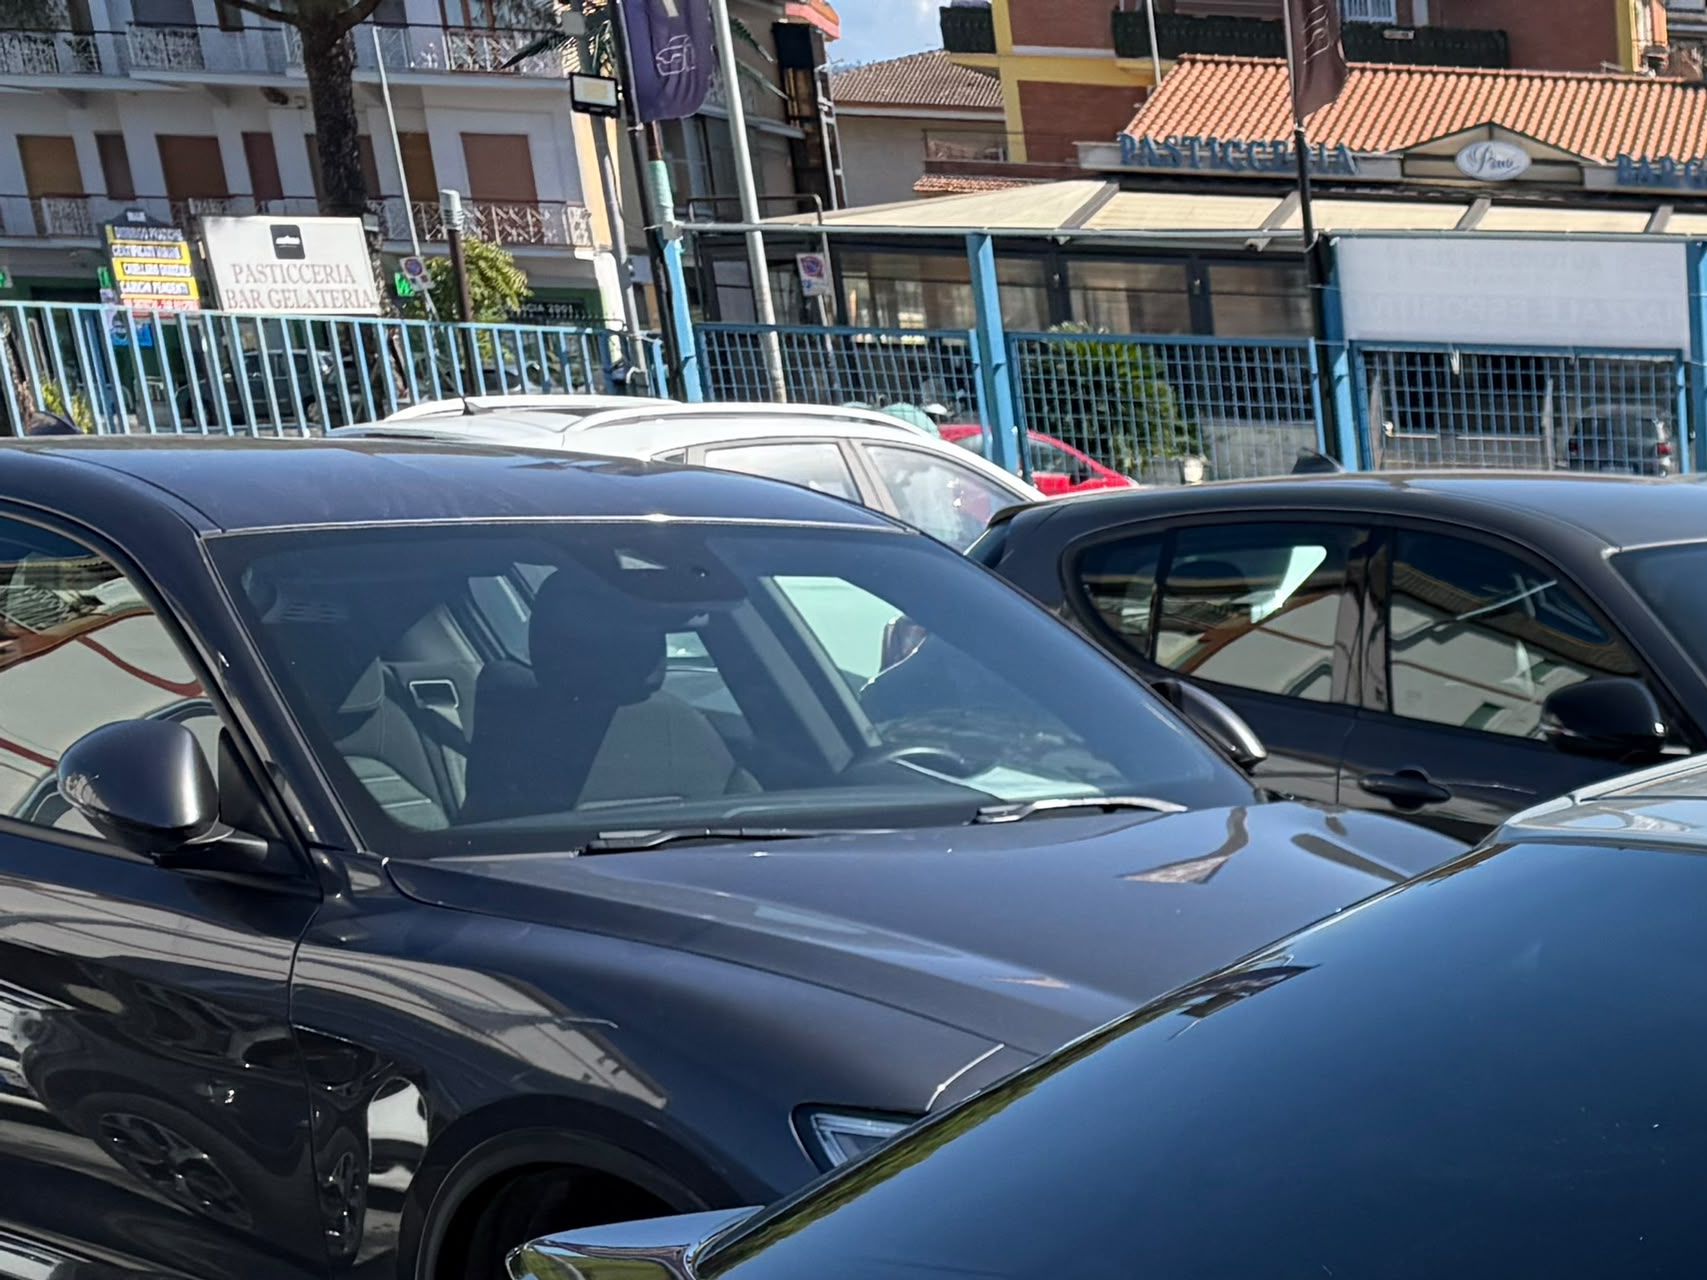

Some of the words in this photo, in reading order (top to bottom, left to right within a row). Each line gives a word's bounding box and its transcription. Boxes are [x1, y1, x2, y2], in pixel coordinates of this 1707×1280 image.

[1117, 132, 1358, 176] PASTICCEIA
[231, 263, 356, 285] PASTICCERIA
[225, 289, 265, 310] BAR
[267, 289, 376, 310] GELATERIA
